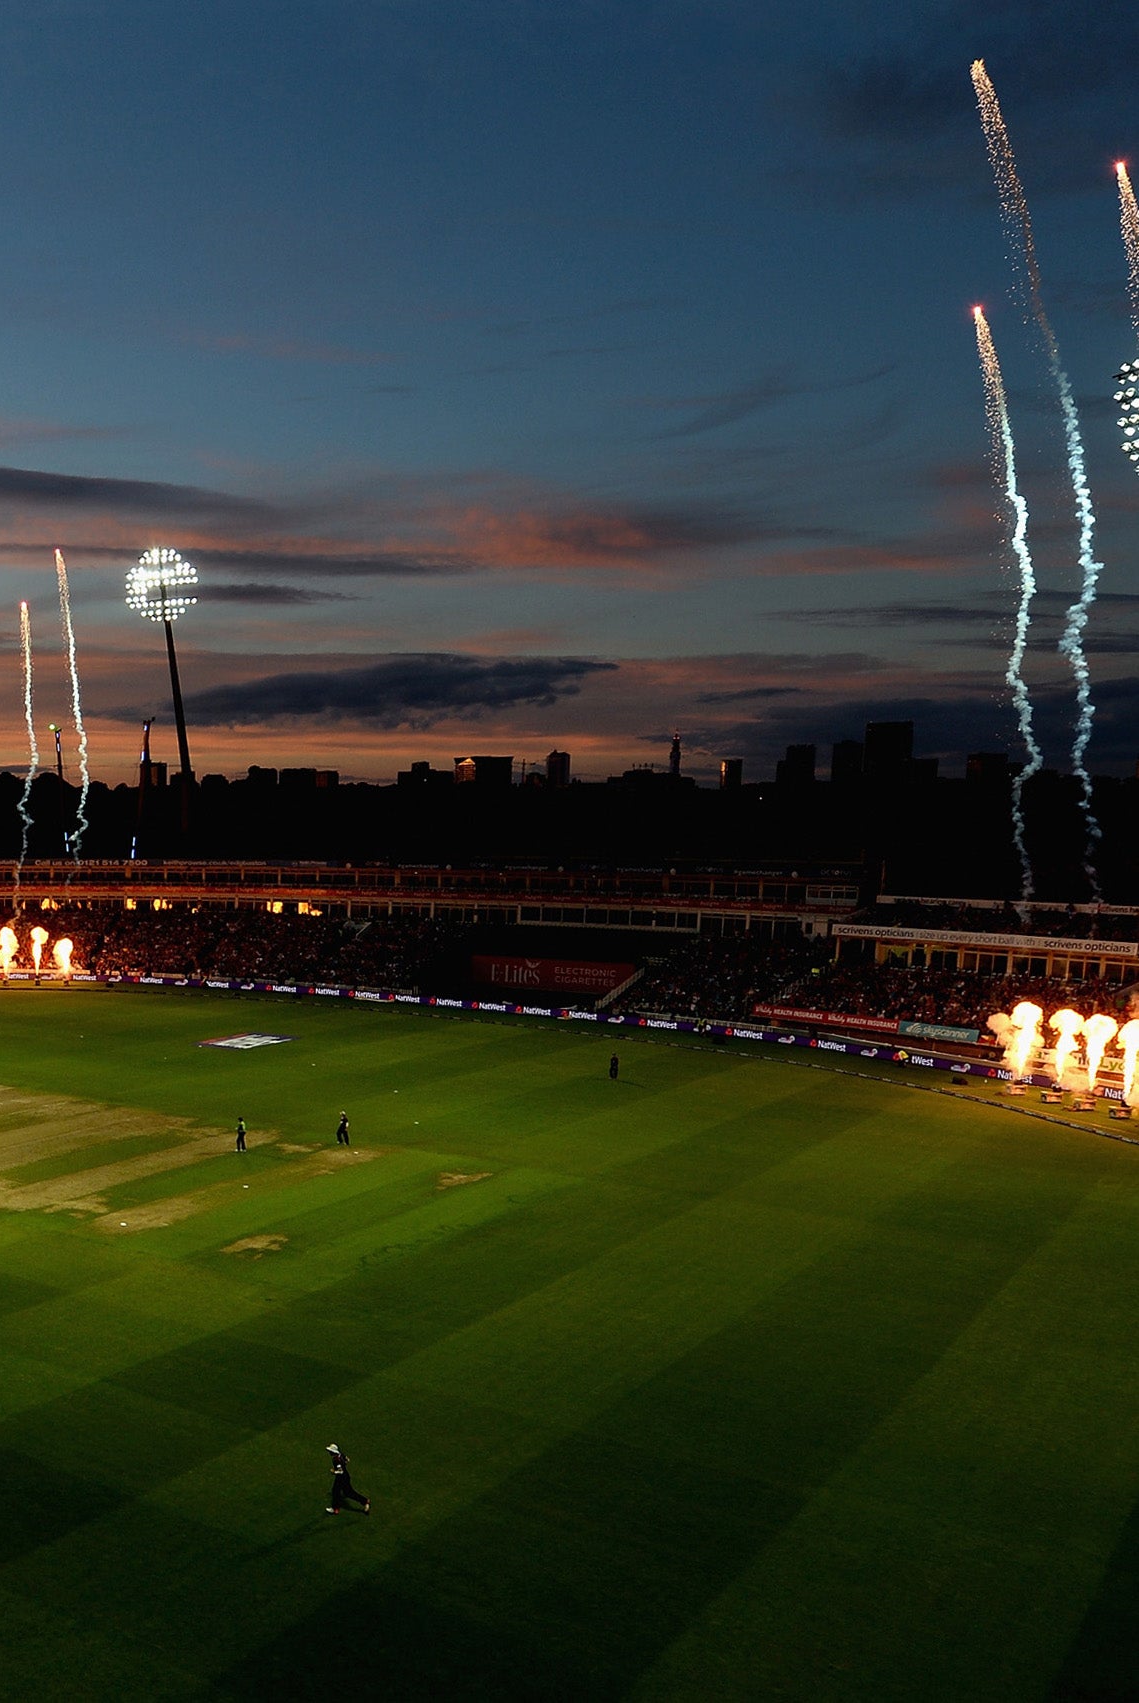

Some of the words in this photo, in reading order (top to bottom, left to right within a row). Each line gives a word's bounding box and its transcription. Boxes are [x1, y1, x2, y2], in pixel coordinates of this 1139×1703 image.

[838, 925, 873, 936] scrivens
[875, 927, 914, 939] opticians
[919, 929, 936, 939] size
[949, 933, 973, 943] every
[975, 934, 997, 944] short
[998, 935, 1014, 945] ball
[1044, 938, 1083, 949] scrivens
[1084, 941, 1131, 953] opticians
[554, 966, 617, 978] ELECTRONIC
[139, 976, 164, 984] NatWest
[554, 975, 616, 987] CIGARETTES
[272, 984, 297, 993] NatWest
[315, 987, 340, 996] NatWest
[354, 990, 380, 999] NatWest
[395, 994, 421, 1003] NatWest
[436, 997, 462, 1007] NatWest
[478, 1002, 506, 1011] NatWest
[522, 1006, 552, 1016] NatWest
[568, 1010, 598, 1021] NatWest
[646, 1019, 678, 1030] NatWest
[773, 1008, 793, 1017] HEALTH
[794, 1010, 823, 1020] INSURANCE
[846, 1016, 866, 1026] HEALTH
[867, 1019, 898, 1030] INSURANCE
[733, 1028, 763, 1040] NatWest
[922, 1025, 970, 1040] skyscanner
[817, 1039, 847, 1052] NatWest
[911, 1055, 934, 1067] tWest
